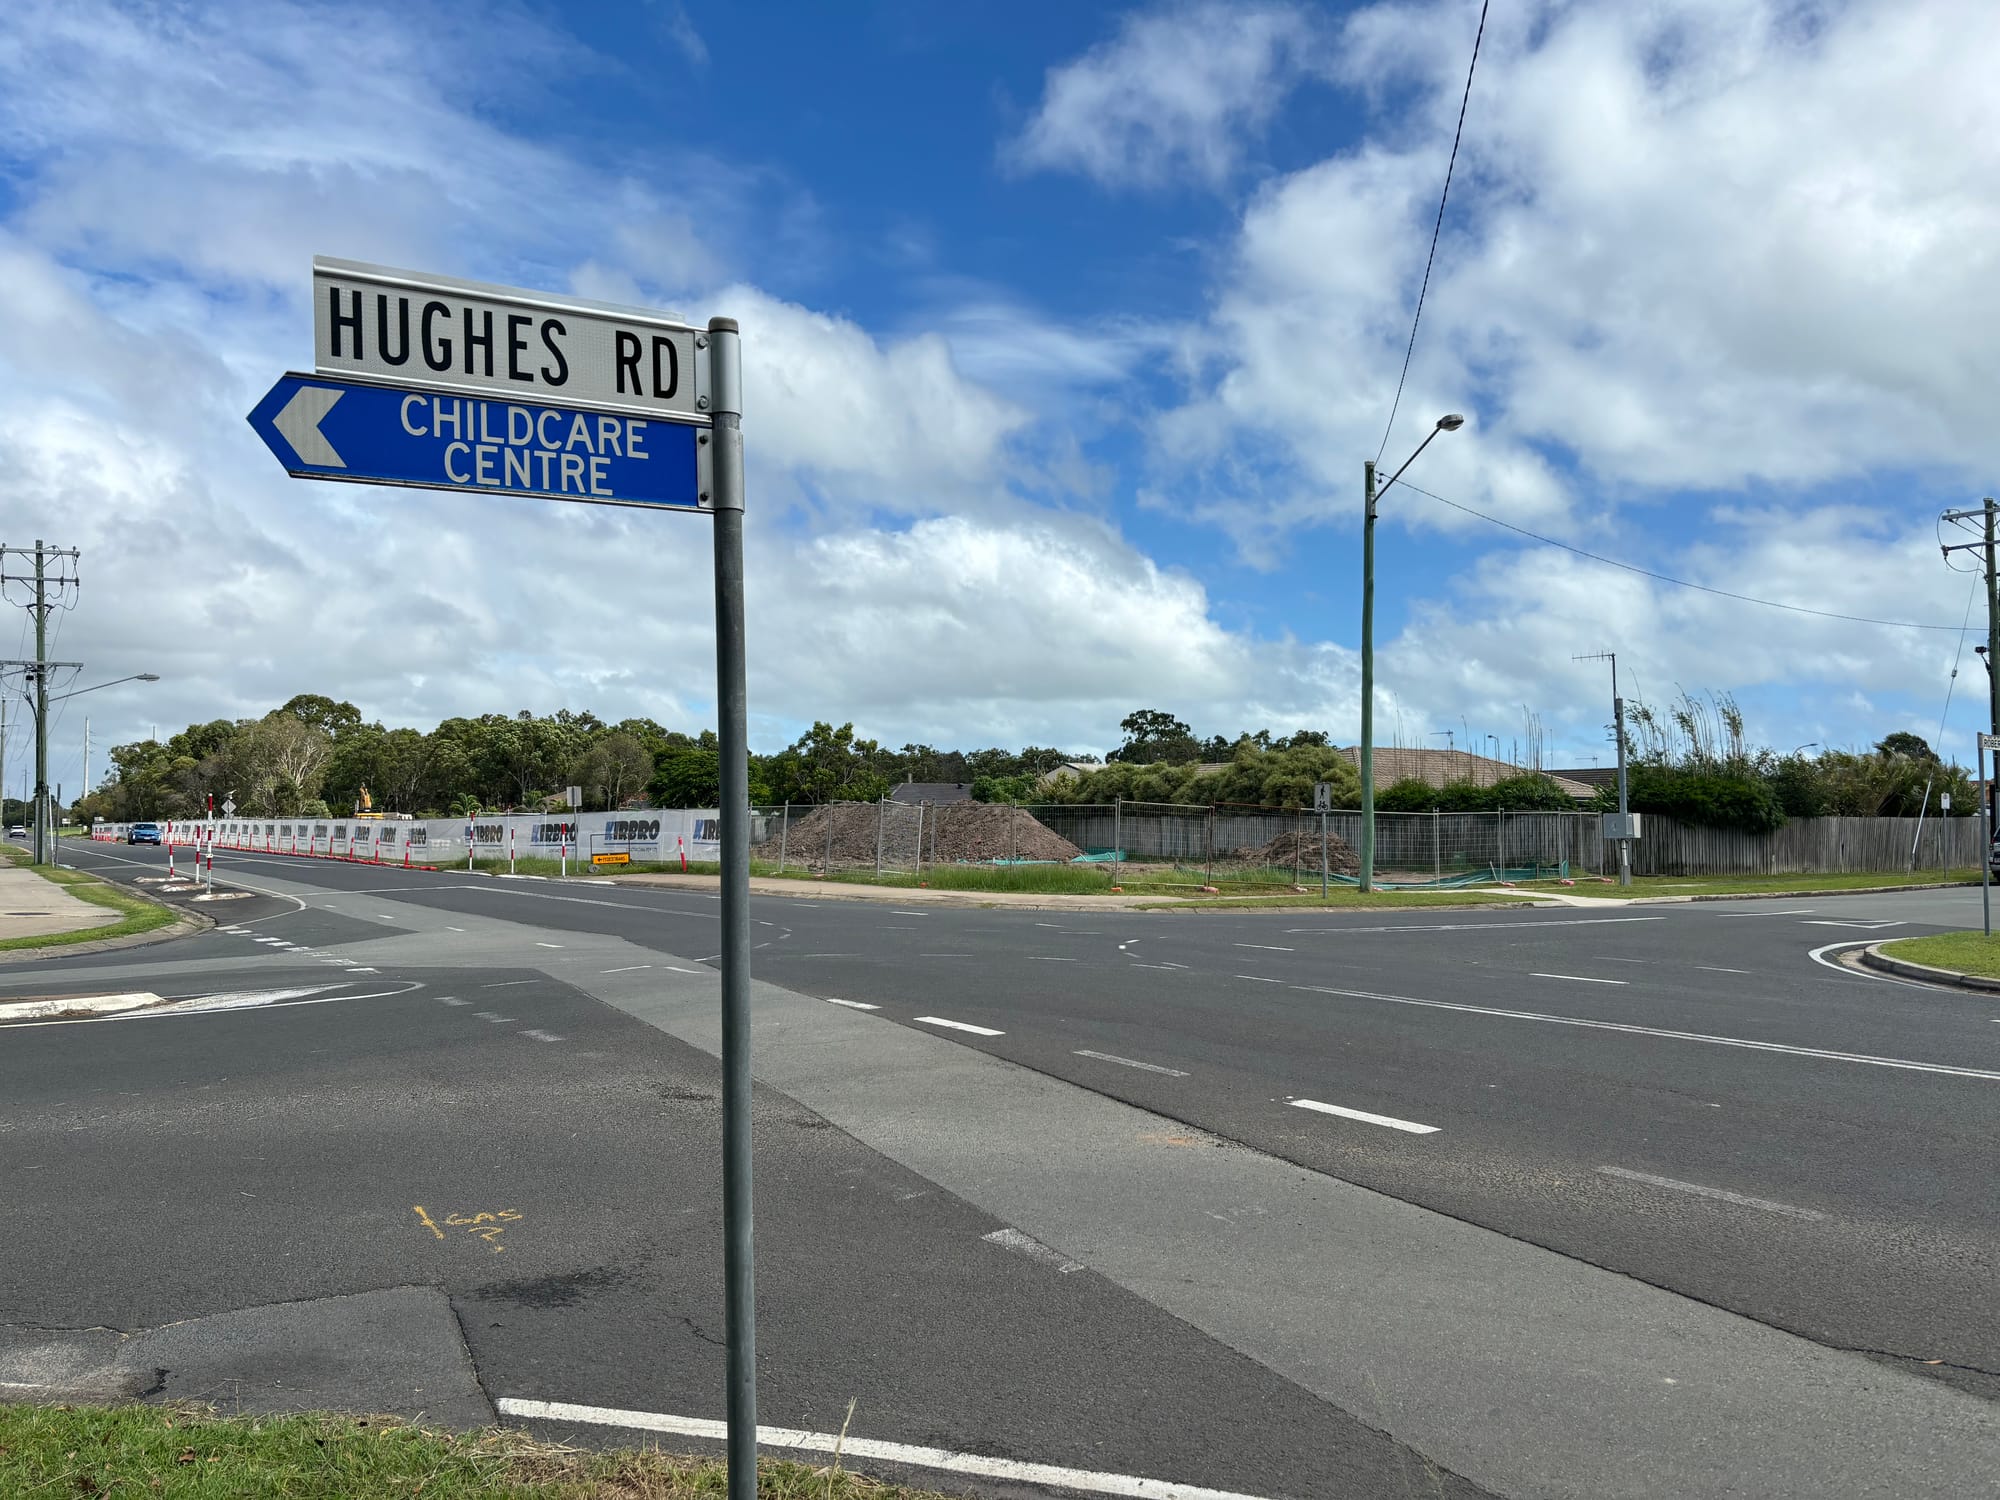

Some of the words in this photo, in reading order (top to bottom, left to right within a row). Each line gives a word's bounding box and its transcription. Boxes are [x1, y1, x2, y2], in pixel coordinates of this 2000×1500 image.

[329, 286, 569, 387] HUGHES
[615, 330, 679, 399] RD
[400, 393, 649, 460] CHILDCARE
[444, 441, 614, 496] CENTRE
[604, 819, 660, 840] KIRBRO
